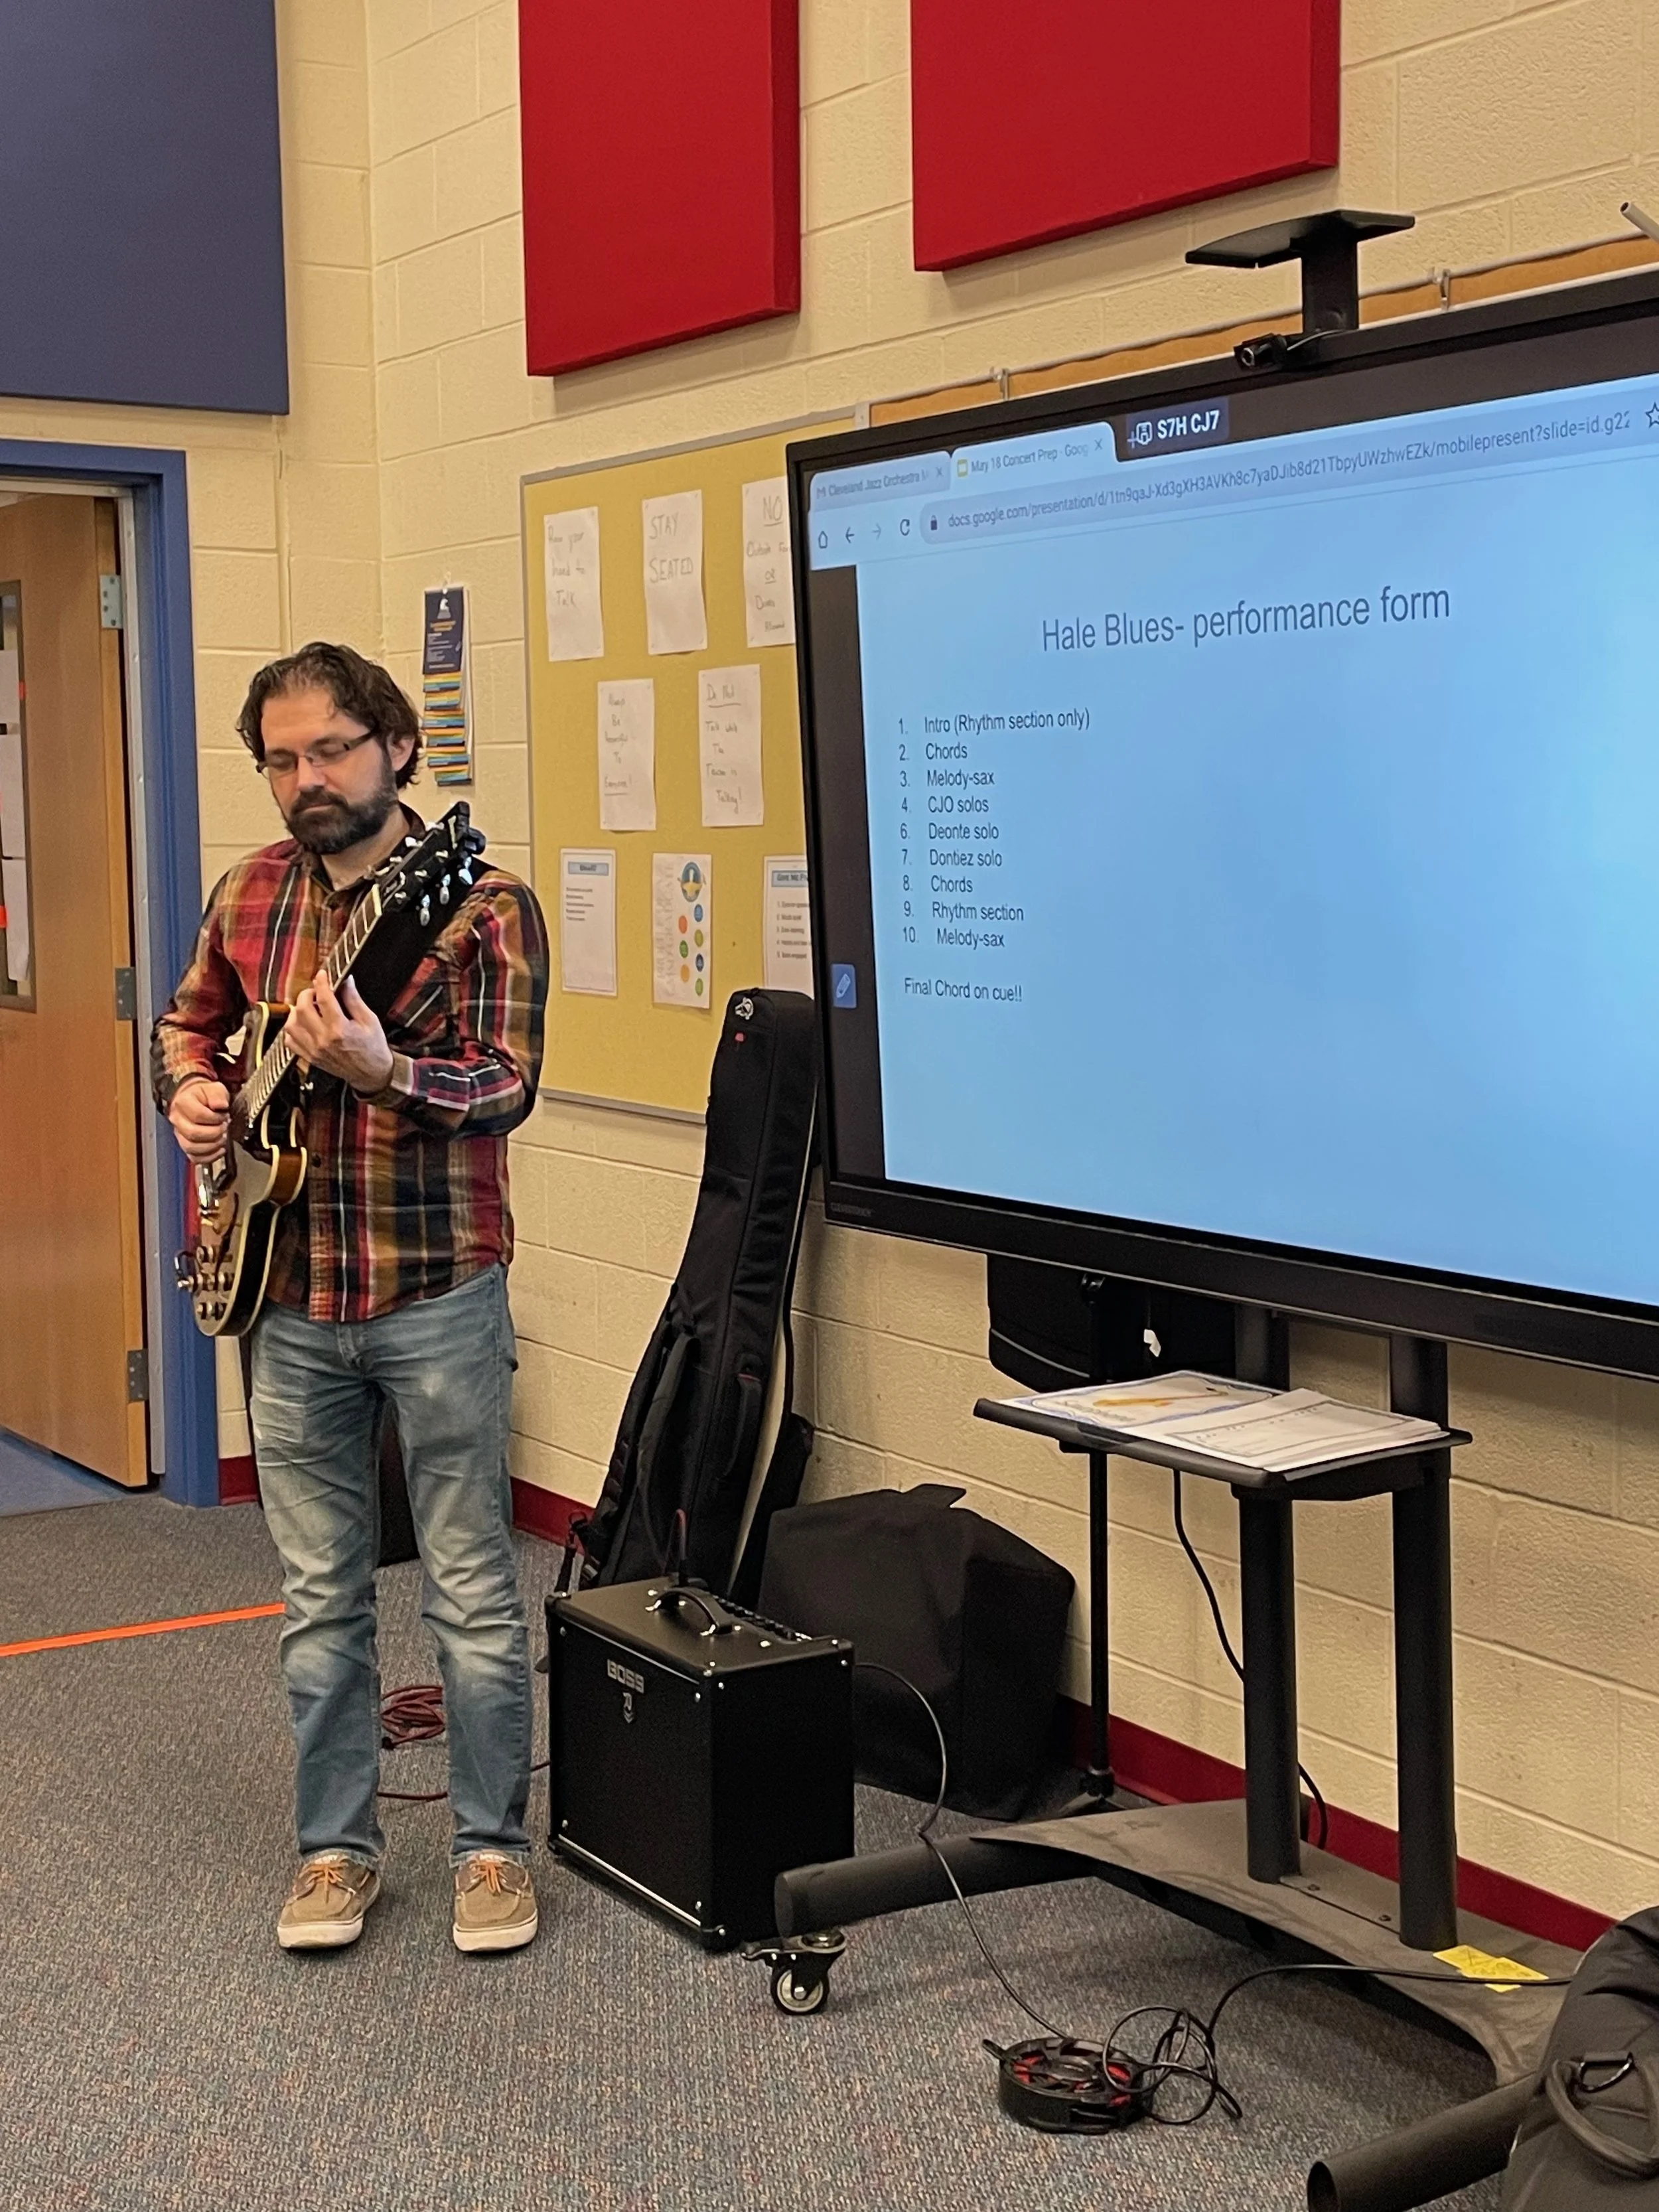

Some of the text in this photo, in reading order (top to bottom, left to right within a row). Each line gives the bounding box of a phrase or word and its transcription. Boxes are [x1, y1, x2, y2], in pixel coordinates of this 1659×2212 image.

[1157, 409, 1220, 439] S7H CJ7
[971, 460, 988, 473] May
[991, 457, 1001, 469] 18
[1003, 451, 1035, 467] Concert
[1038, 449, 1057, 461] Prep
[830, 480, 863, 496] Cleveland
[865, 477, 882, 490] Jazz
[883, 472, 920, 488] Orchestra
[763, 495, 783, 522] NO
[649, 511, 679, 540] STAY
[650, 557, 693, 583] SEATED
[1043, 585, 1449, 652] Hale Blues- performance form
[899, 707, 1090, 737] 1. Intro (Rhythm section only)
[899, 741, 968, 761] 2. Chords
[899, 769, 995, 790] 3. Melody-sax
[901, 795, 989, 813] 4. CJO solos
[900, 822, 999, 840] 6. Deonte solo
[901, 848, 912, 865] 7.
[977, 849, 1002, 867] solo
[902, 874, 973, 893] 8. Chords
[903, 901, 1024, 923] 9. Rhythm section
[937, 927, 1005, 950] Melody-sax
[904, 977, 1022, 1002] Final Chord on cue!!
[607, 1659, 644, 1695] BOSS
